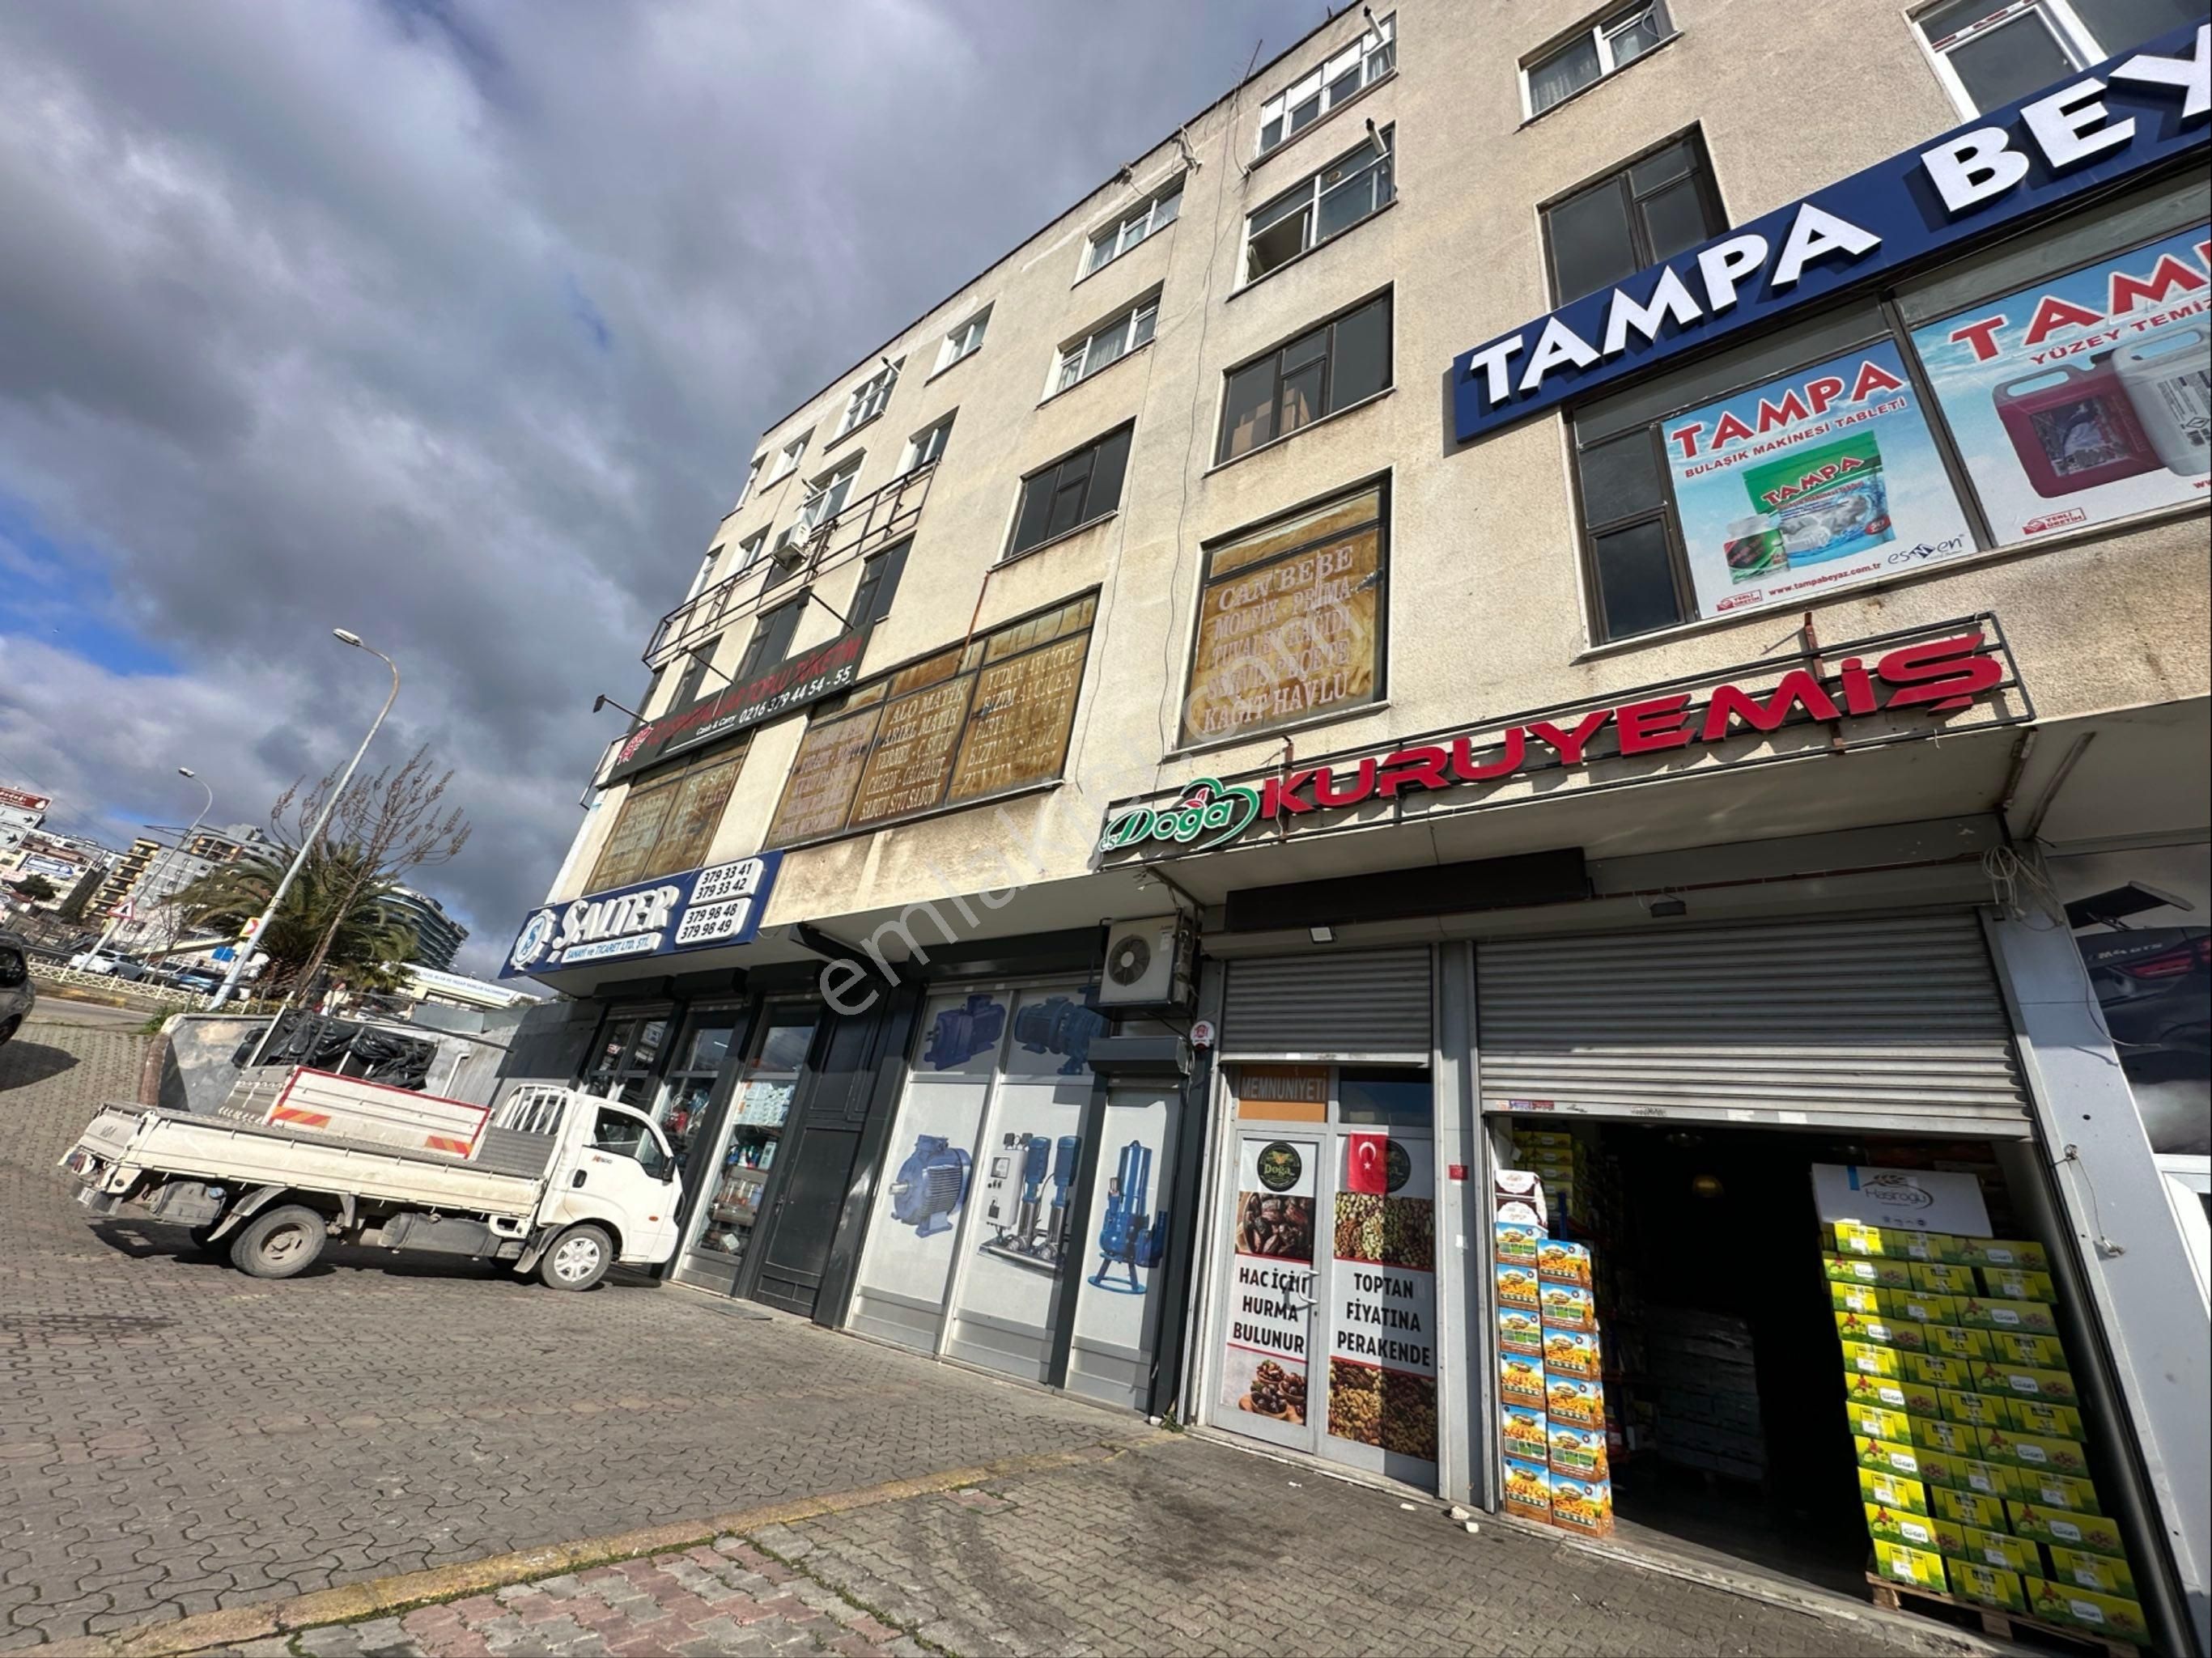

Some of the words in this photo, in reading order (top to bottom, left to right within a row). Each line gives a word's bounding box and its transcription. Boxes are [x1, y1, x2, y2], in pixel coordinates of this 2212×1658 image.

[1470, 202, 1883, 405] TAMPA
[2030, 328, 2121, 365] YÜZEY
[2130, 298, 2211, 332] TEMİ
[1671, 360, 1904, 459] TAMPA
[1685, 449, 1749, 478] BULAŞIK
[1753, 422, 1831, 456] MAKİNESİ
[1835, 396, 1907, 429] TABLETİ
[1761, 456, 1864, 506] TAMPA
[1219, 575, 1274, 612] CAN
[1279, 545, 1354, 592] BEBE
[1768, 562, 1881, 597] www.tampabeyaz.com.tr
[739, 702, 766, 723] 0216
[791, 686, 806, 701] 44
[807, 678, 825, 694] 54
[833, 664, 853, 685] 55
[1272, 672, 1349, 717] HAVLU
[889, 699, 919, 725] ALO
[1263, 632, 2004, 820] KURUYEMİŞ
[696, 884, 716, 900] 379
[717, 880, 732, 896] 33
[732, 877, 748, 892] 42
[702, 869, 722, 884] 379
[723, 866, 737, 880] 33
[738, 862, 753, 876] 41
[681, 925, 701, 939] 379
[701, 922, 716, 936] 98
[716, 918, 732, 933] 49
[687, 909, 707, 924] 379
[707, 905, 722, 921] 98
[722, 903, 738, 917] 48
[1238, 1266, 1267, 1287] HAC
[1353, 1272, 1414, 1300] TOPTAN
[1242, 1295, 1298, 1322] HURMA
[1346, 1297, 1421, 1333] FİYATINA
[1233, 1321, 1305, 1355] BULUNUR
[1337, 1330, 1430, 1367] PERAKENDE
